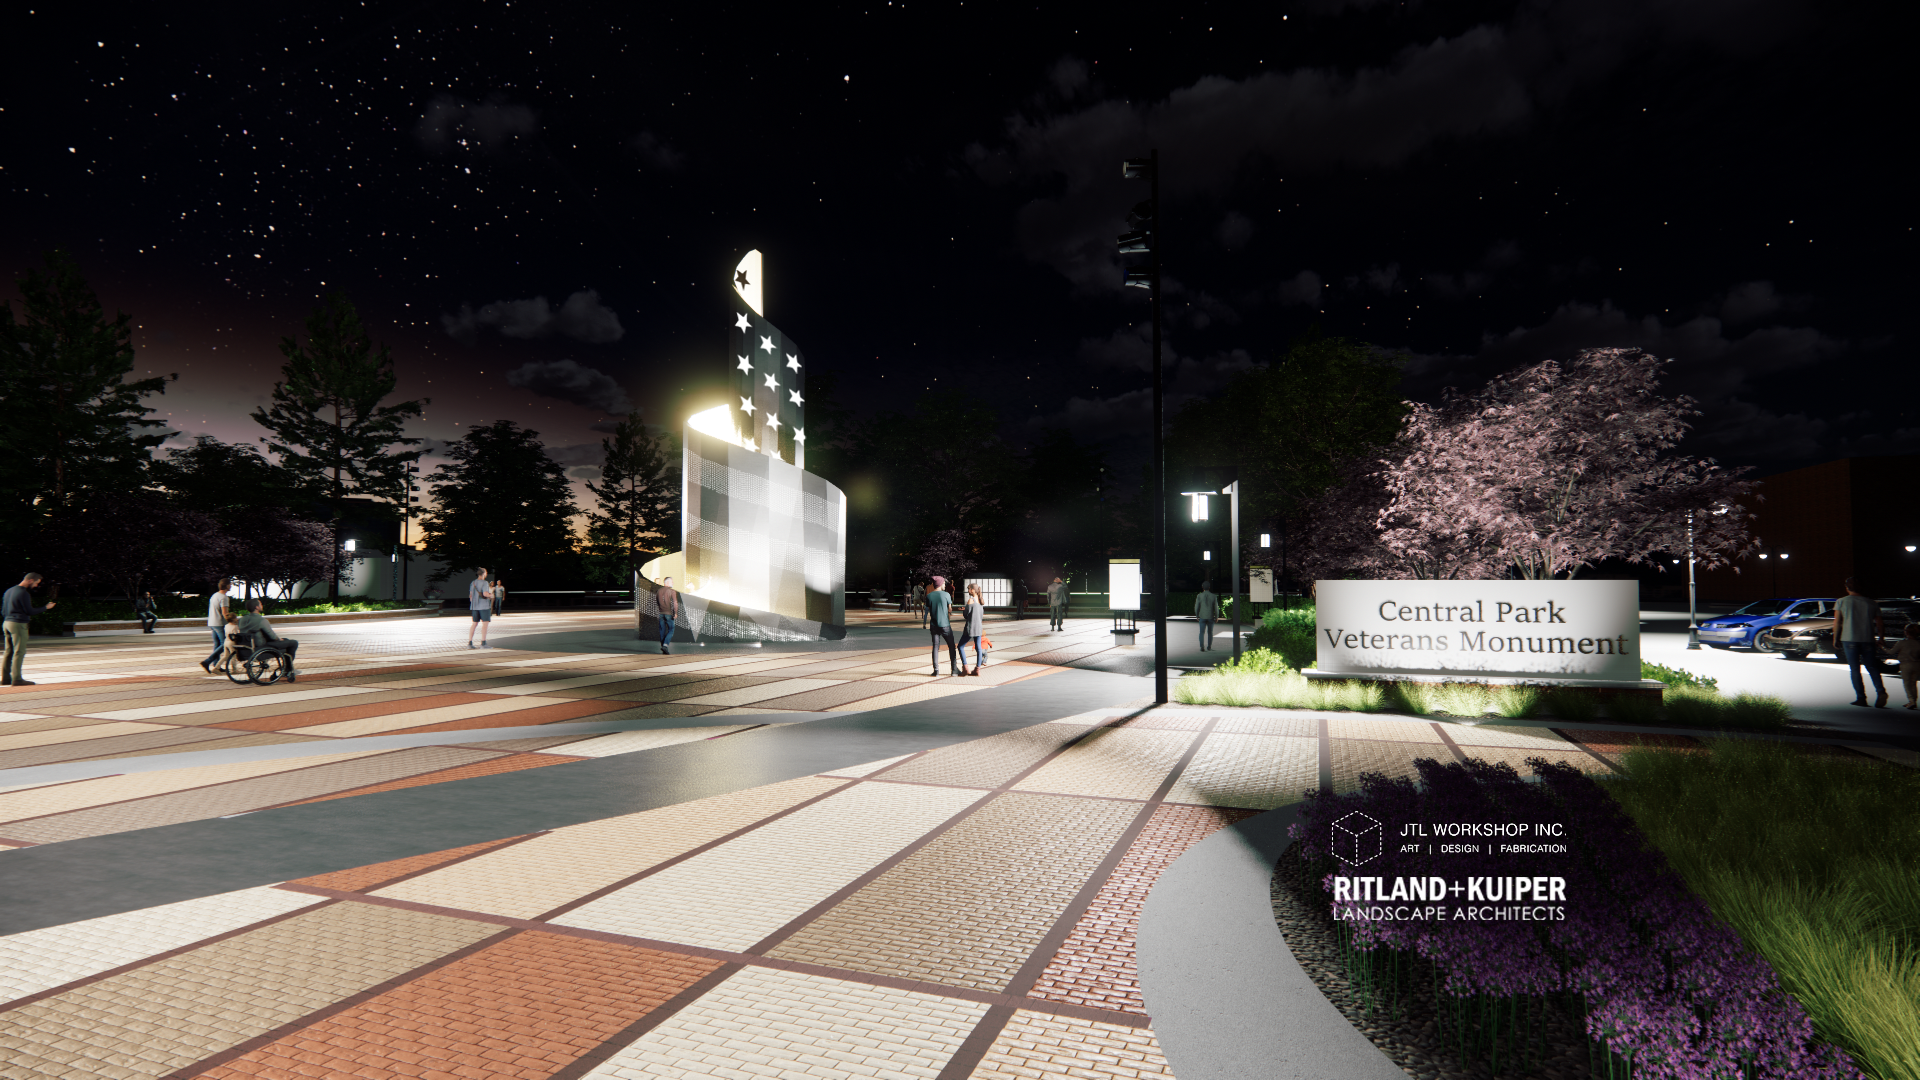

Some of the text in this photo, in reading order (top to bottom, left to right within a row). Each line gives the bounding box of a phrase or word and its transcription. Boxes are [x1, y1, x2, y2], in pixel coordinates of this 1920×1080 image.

[1378, 599, 1567, 624] Central Park
[1323, 628, 1630, 656] Veterans Monument
